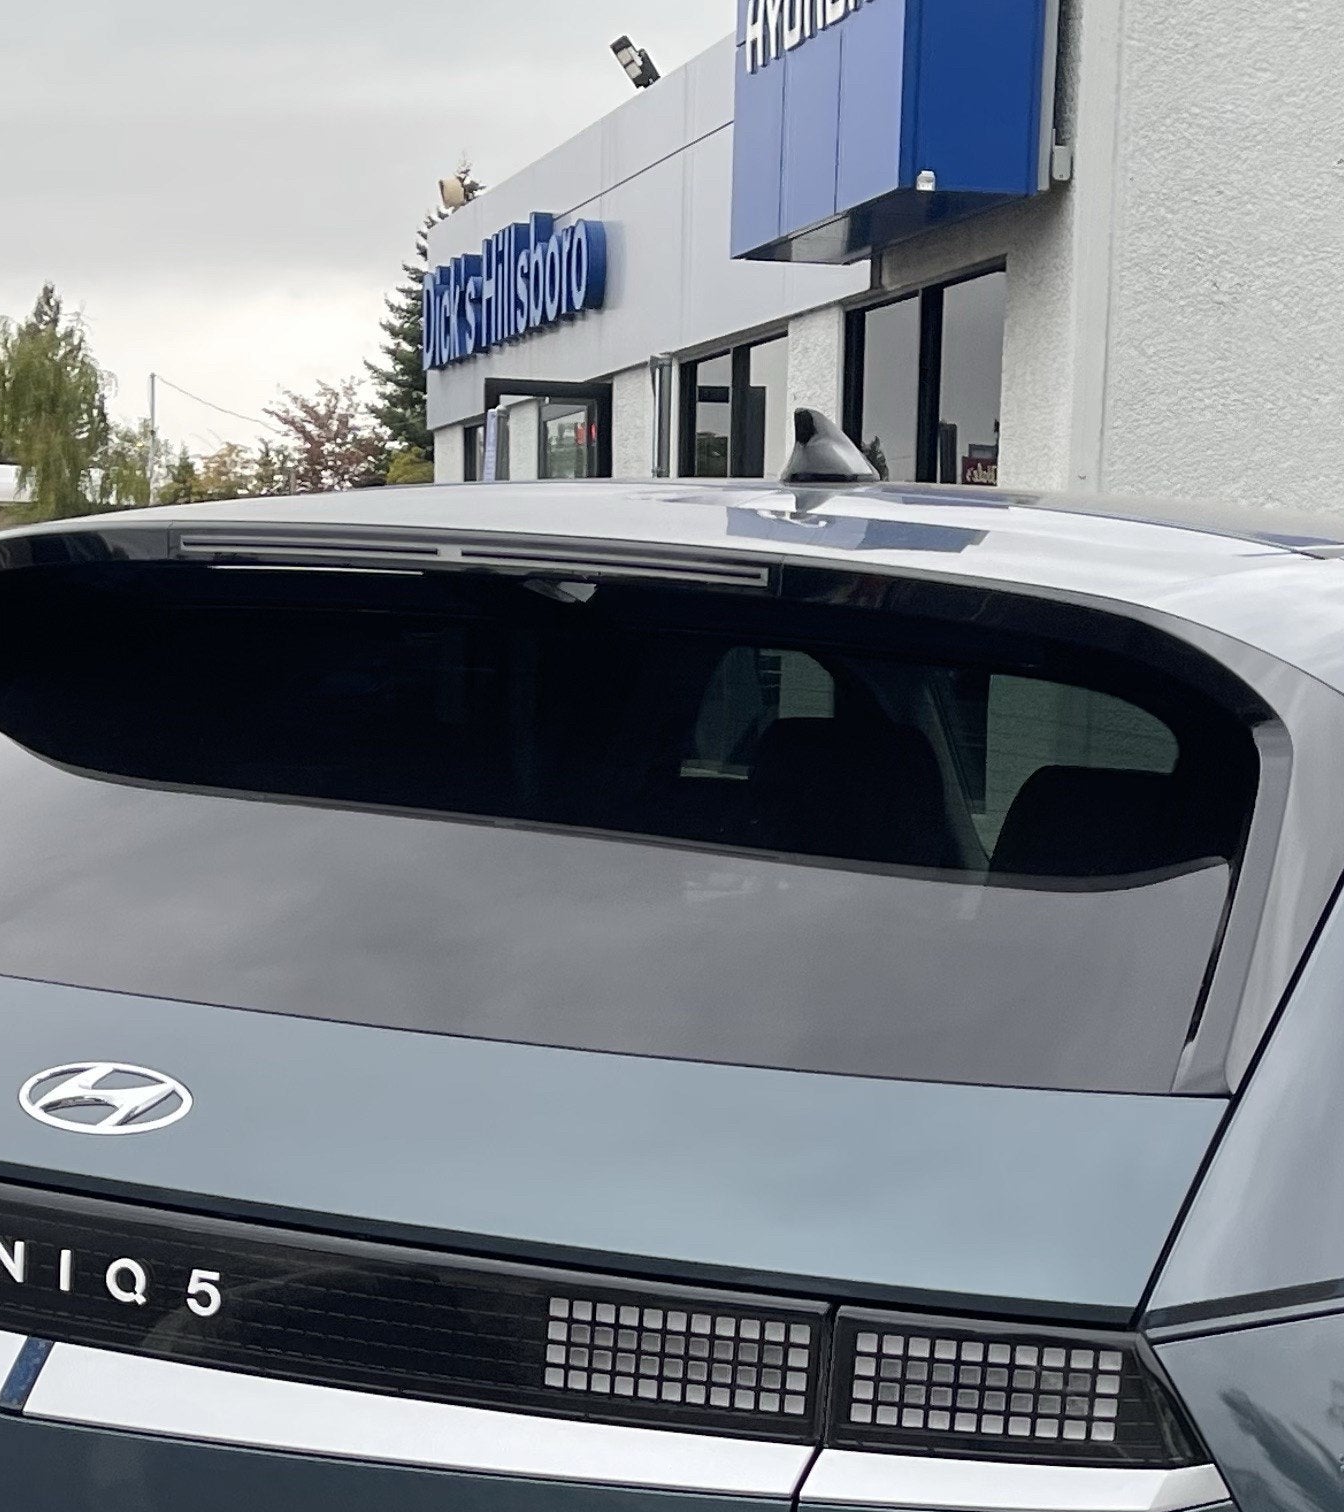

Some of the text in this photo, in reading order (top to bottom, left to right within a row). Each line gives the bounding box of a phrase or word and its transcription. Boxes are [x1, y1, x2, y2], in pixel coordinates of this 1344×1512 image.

[423, 212, 593, 371] Dick's Hillsboro
[186, 1269, 222, 1317] 5
